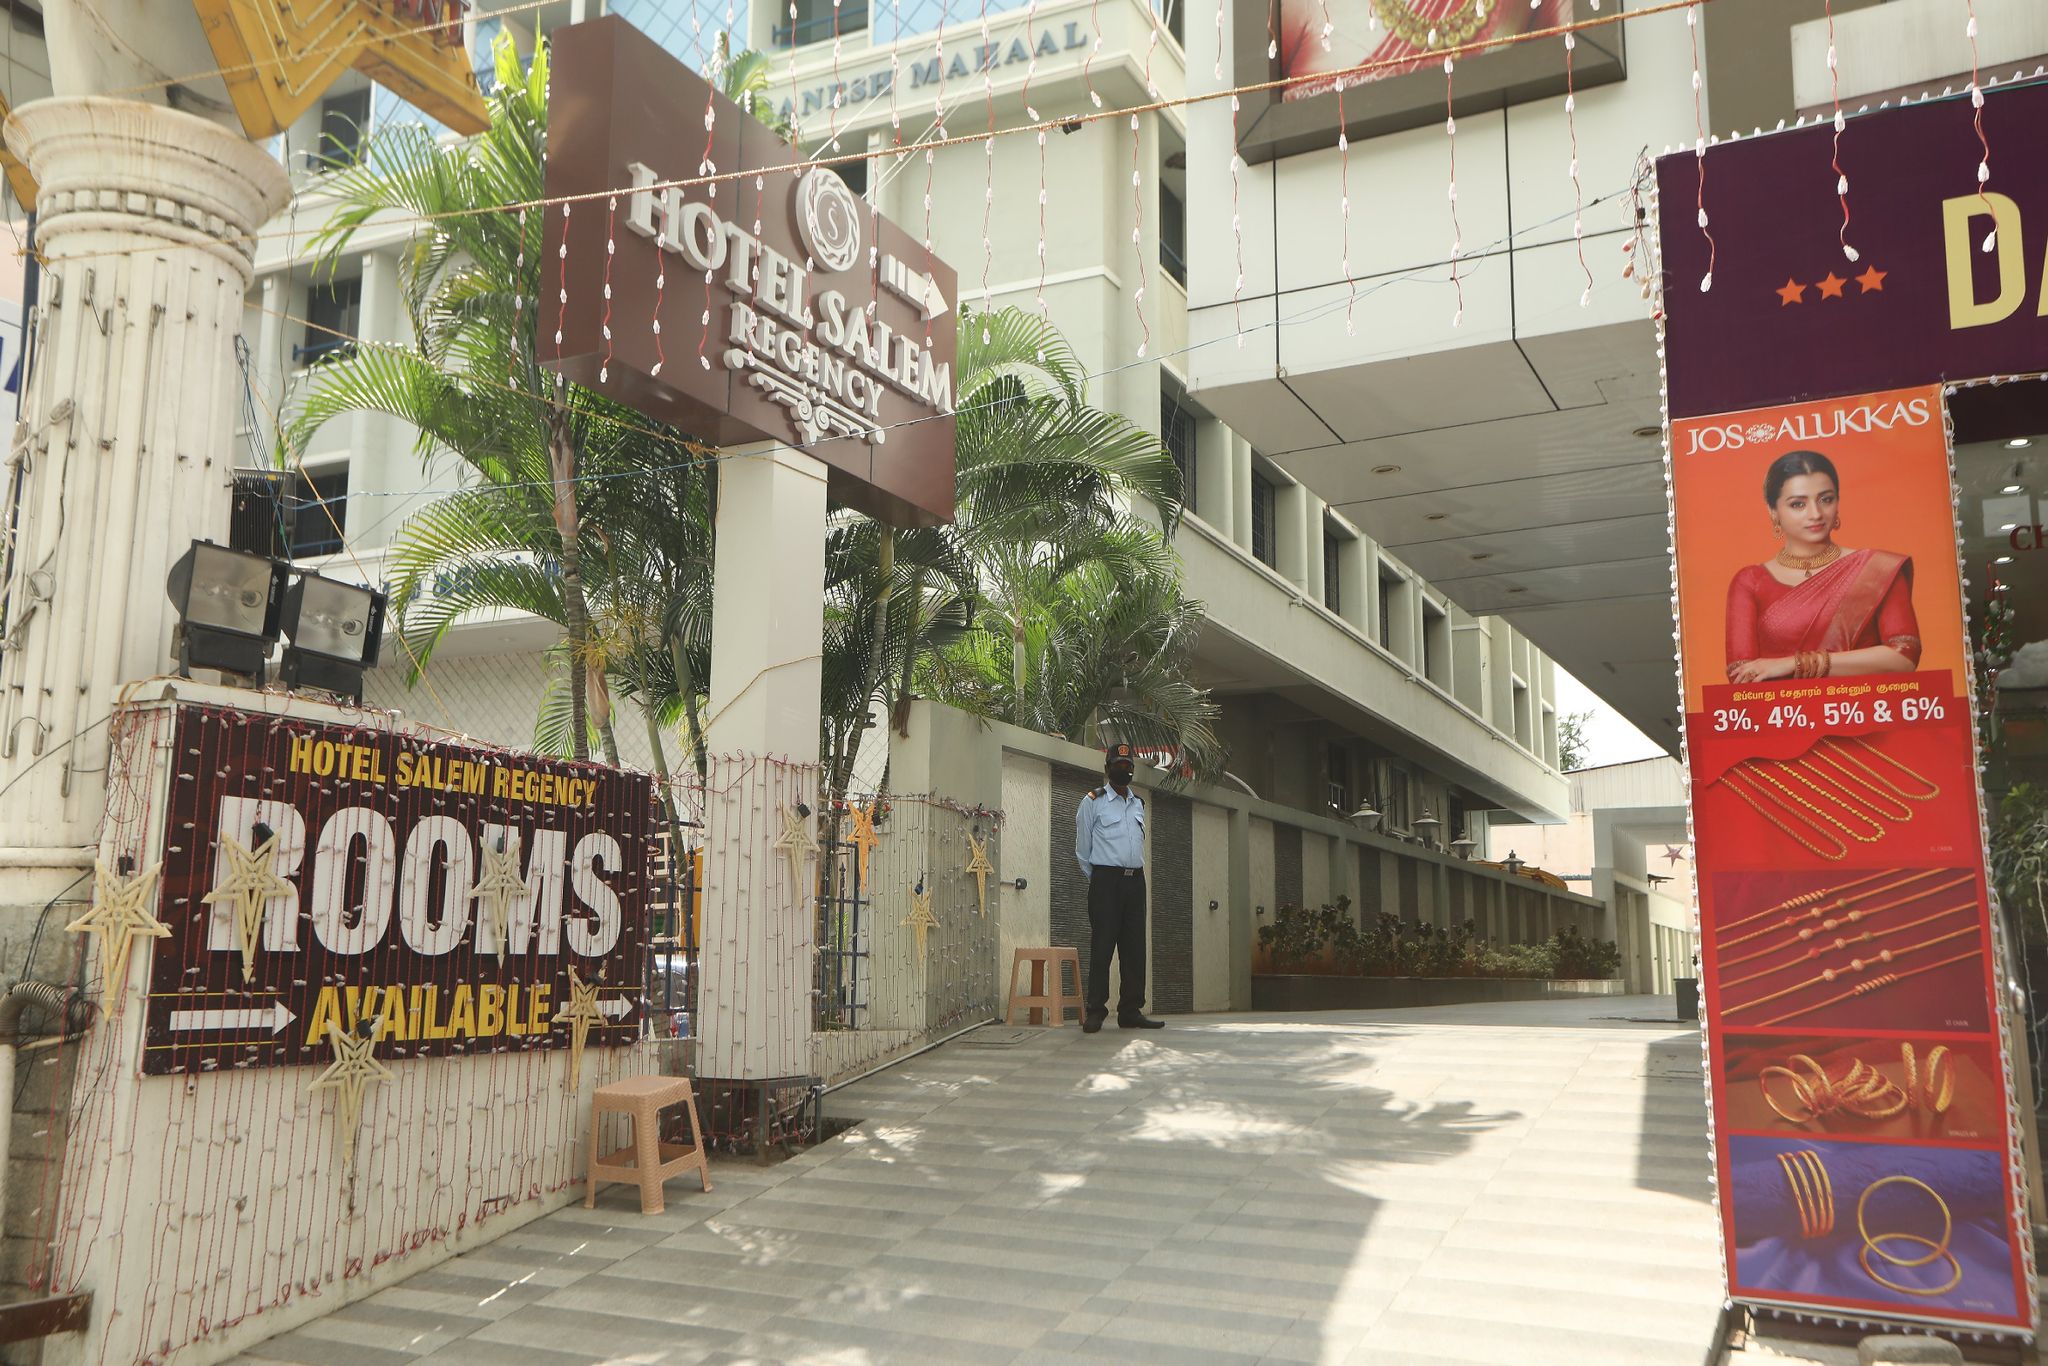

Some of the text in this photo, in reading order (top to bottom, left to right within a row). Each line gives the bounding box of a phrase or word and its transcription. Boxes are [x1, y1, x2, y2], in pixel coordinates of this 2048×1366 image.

[776, 22, 1087, 118] ANESH MAHAAL
[625, 162, 954, 415] HOTEL SALEM
[1942, 191, 2048, 330] D
[729, 302, 884, 417] REGENCY
[1686, 399, 1930, 455] JOS ALUKKAS
[1713, 697, 1945, 732] 3%, 4%, 5% & 6%
[289, 738, 597, 807] HOTEL SALEM REGENCY
[206, 795, 623, 958] ROOMS
[305, 983, 552, 1046] AVAILABLE
